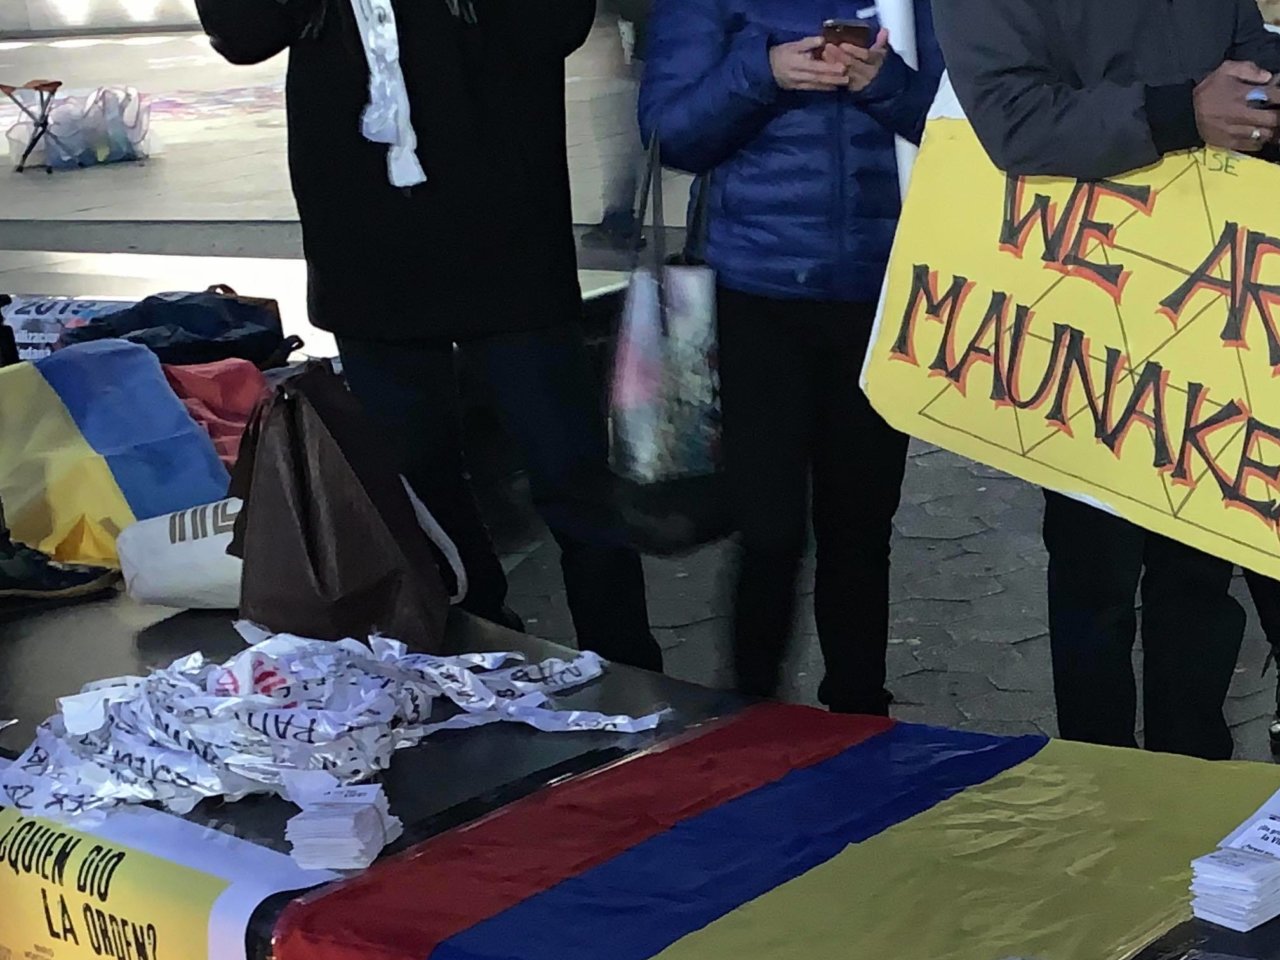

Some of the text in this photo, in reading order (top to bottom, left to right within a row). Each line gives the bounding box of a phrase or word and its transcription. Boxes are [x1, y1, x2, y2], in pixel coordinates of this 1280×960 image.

[998, 174, 1158, 304] WE
[77, 844, 126, 902] DIO
[40, 888, 80, 946] LA
